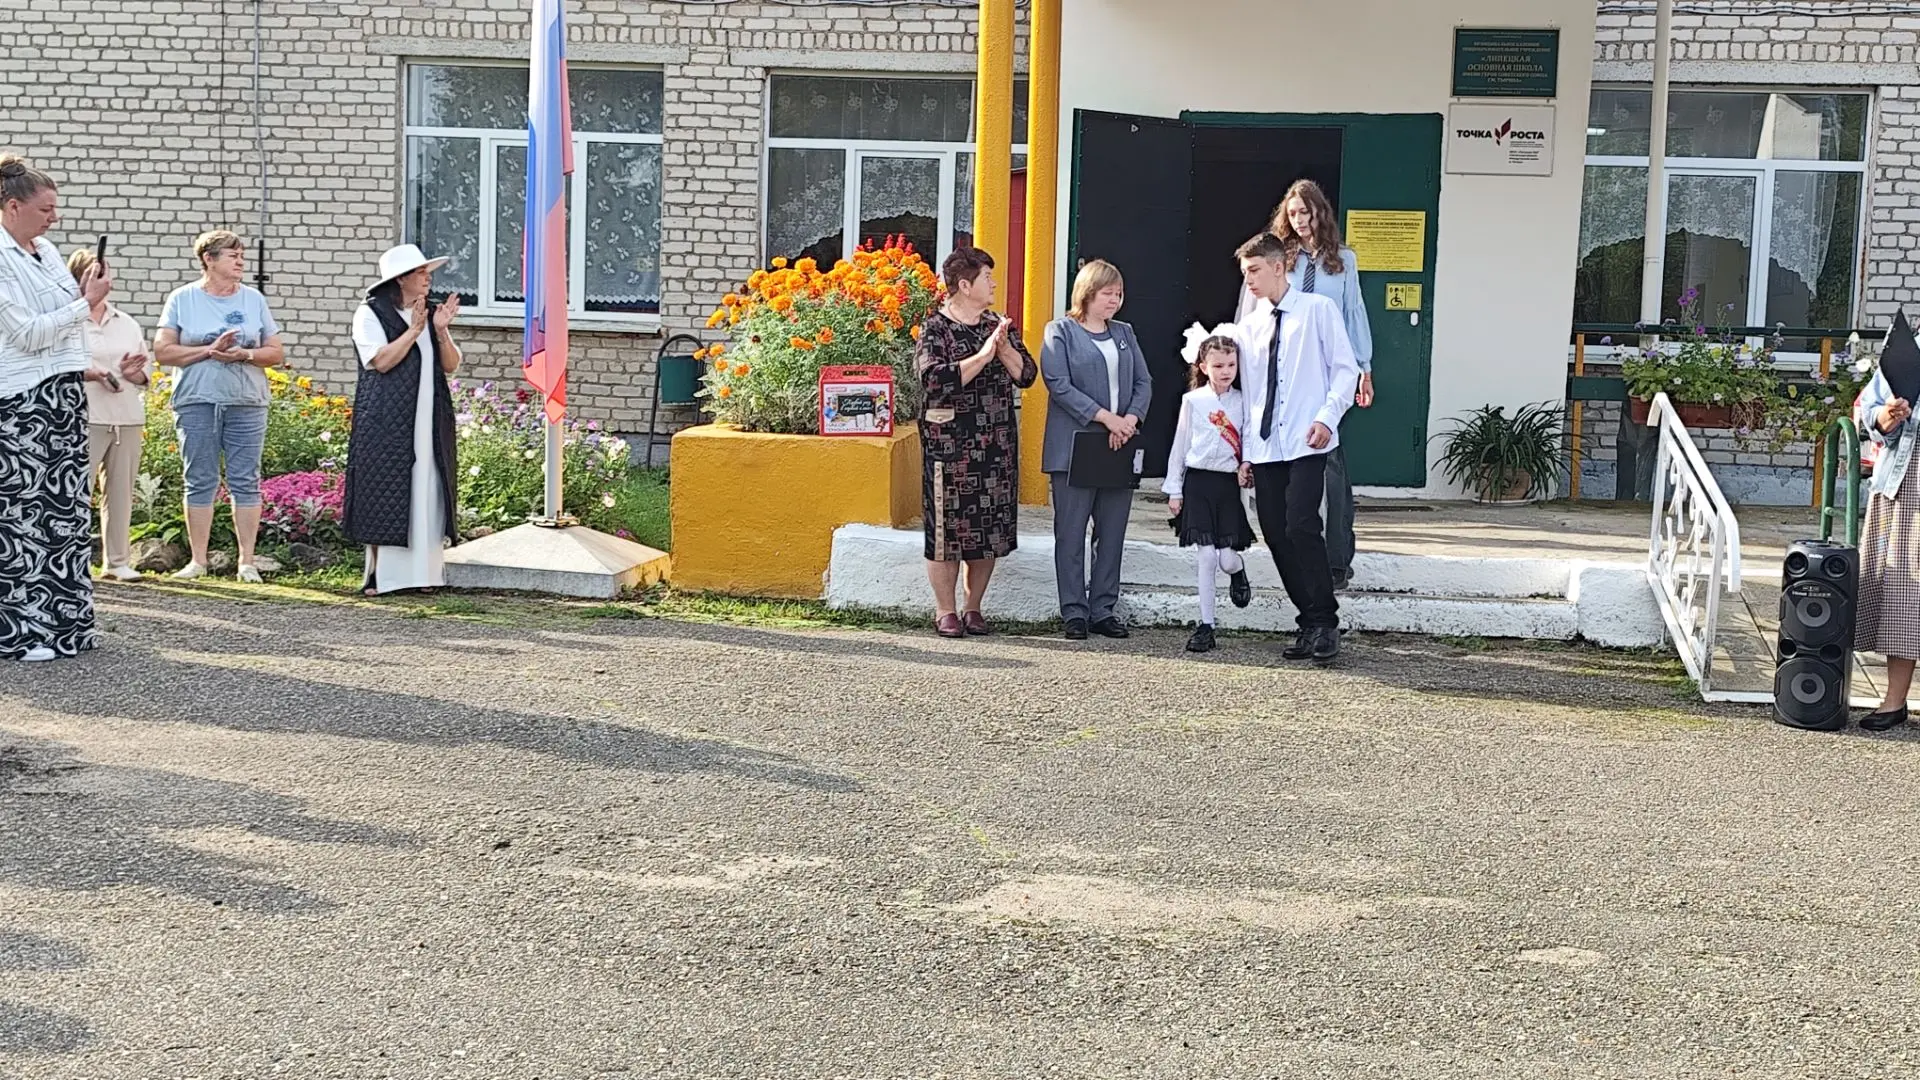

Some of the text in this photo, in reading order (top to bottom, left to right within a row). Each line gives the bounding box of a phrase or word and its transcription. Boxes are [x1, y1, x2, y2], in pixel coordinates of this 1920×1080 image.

[1513, 64, 1543, 72] ШКОЛА
[1456, 129, 1545, 140] ТОЧКА РОСТА
